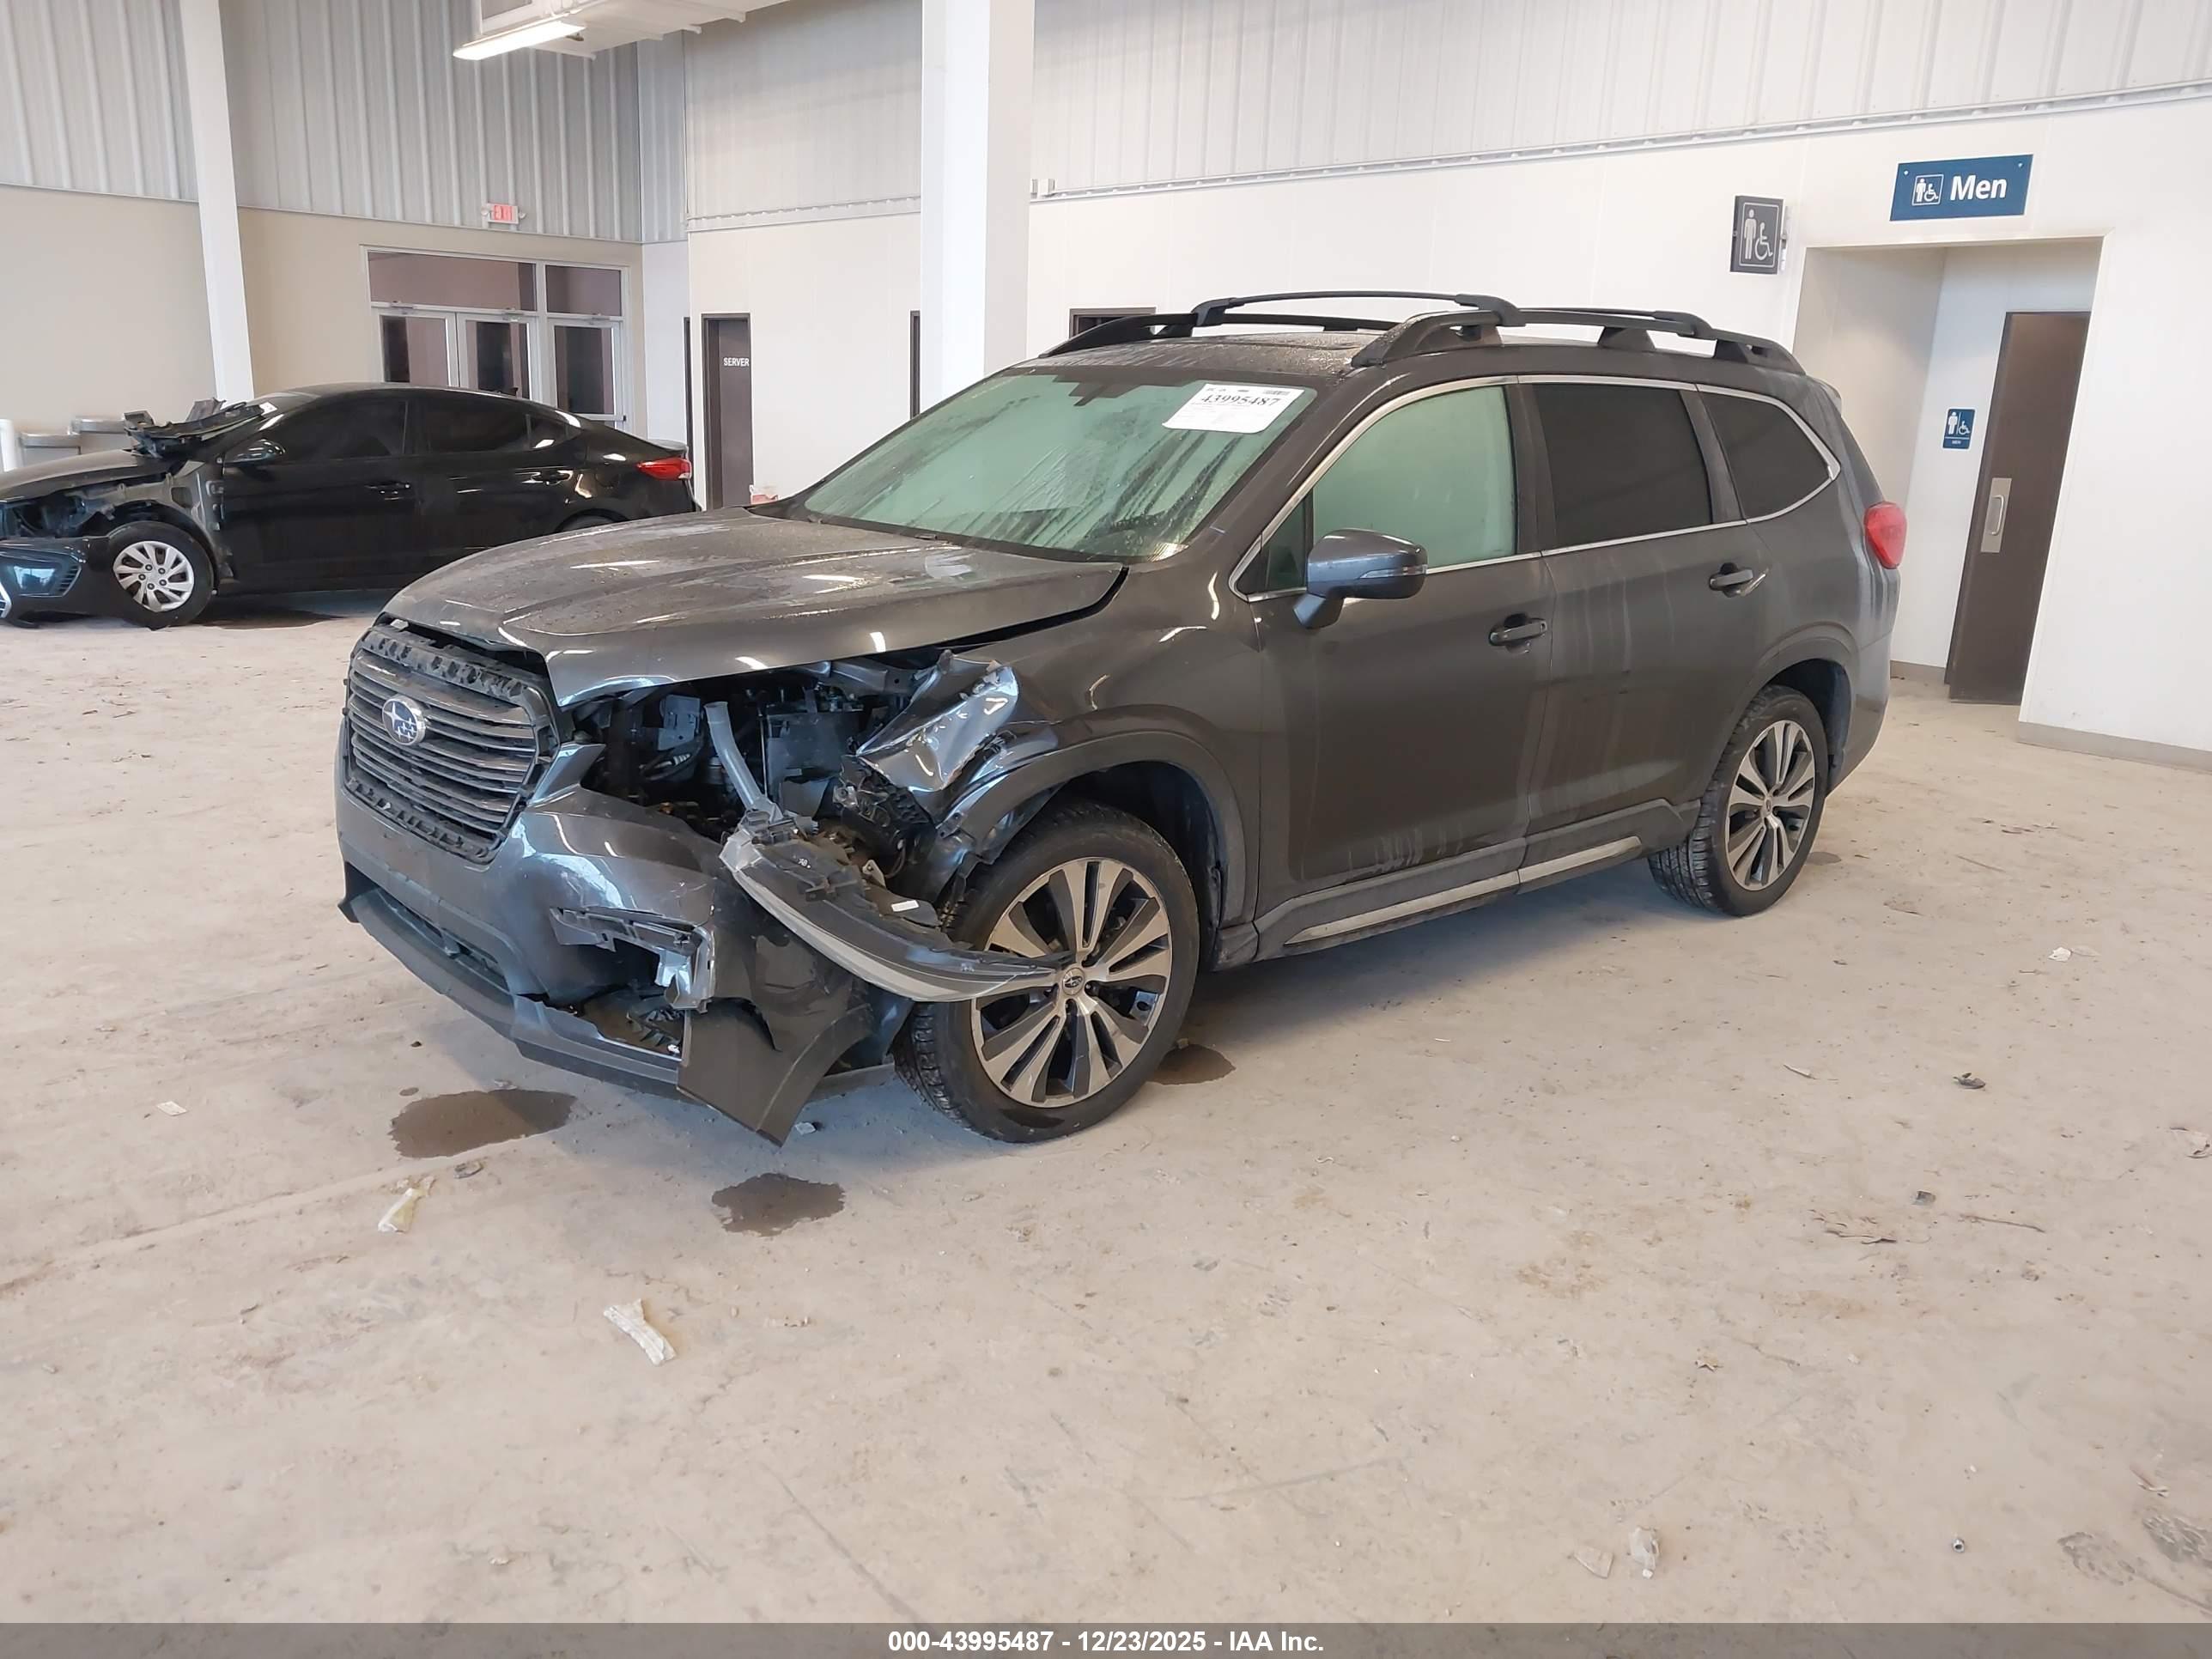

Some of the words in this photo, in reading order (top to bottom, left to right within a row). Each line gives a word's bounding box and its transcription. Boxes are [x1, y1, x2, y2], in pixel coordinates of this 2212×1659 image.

[1950, 174, 2008, 201] Men
[723, 357, 750, 367] SERVER
[1201, 394, 1281, 406] 43995487
